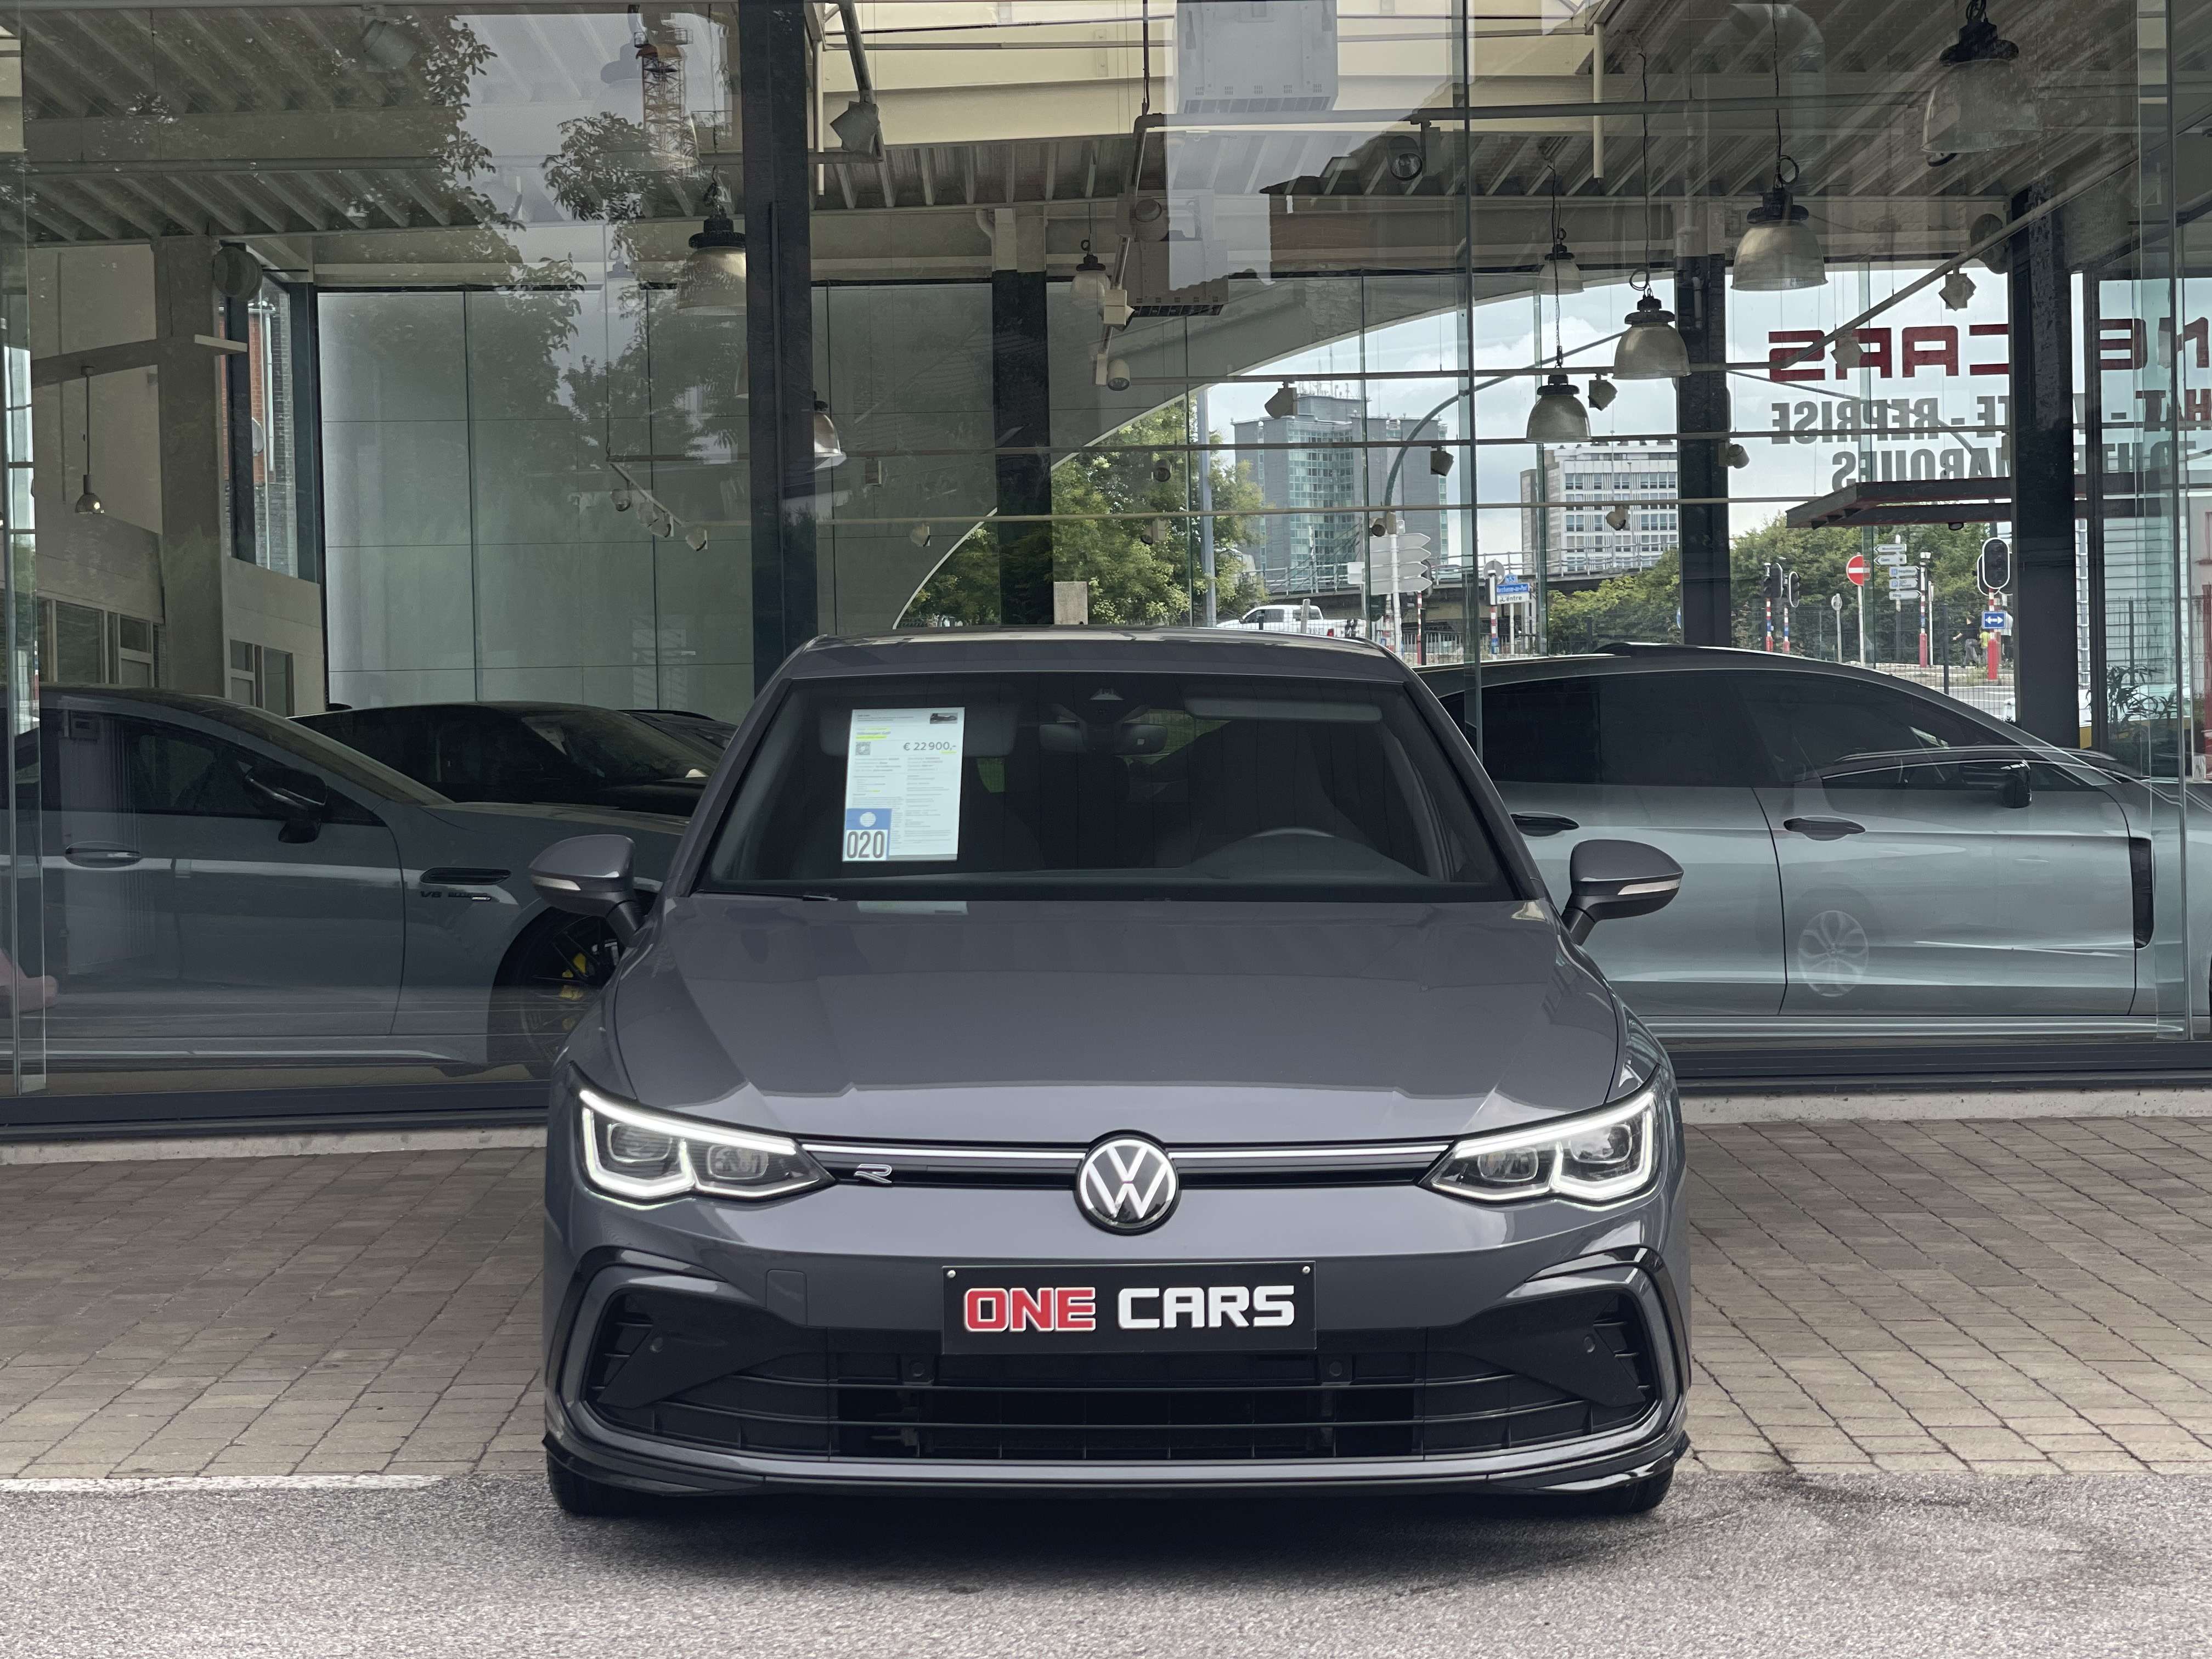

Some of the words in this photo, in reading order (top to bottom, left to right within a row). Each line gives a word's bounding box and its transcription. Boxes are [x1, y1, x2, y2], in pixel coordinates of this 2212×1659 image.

[847, 831, 885, 859] 020
[854, 1164, 892, 1184] R
[964, 1287, 1096, 1331] ONE
[1118, 1285, 1295, 1329] CARS
